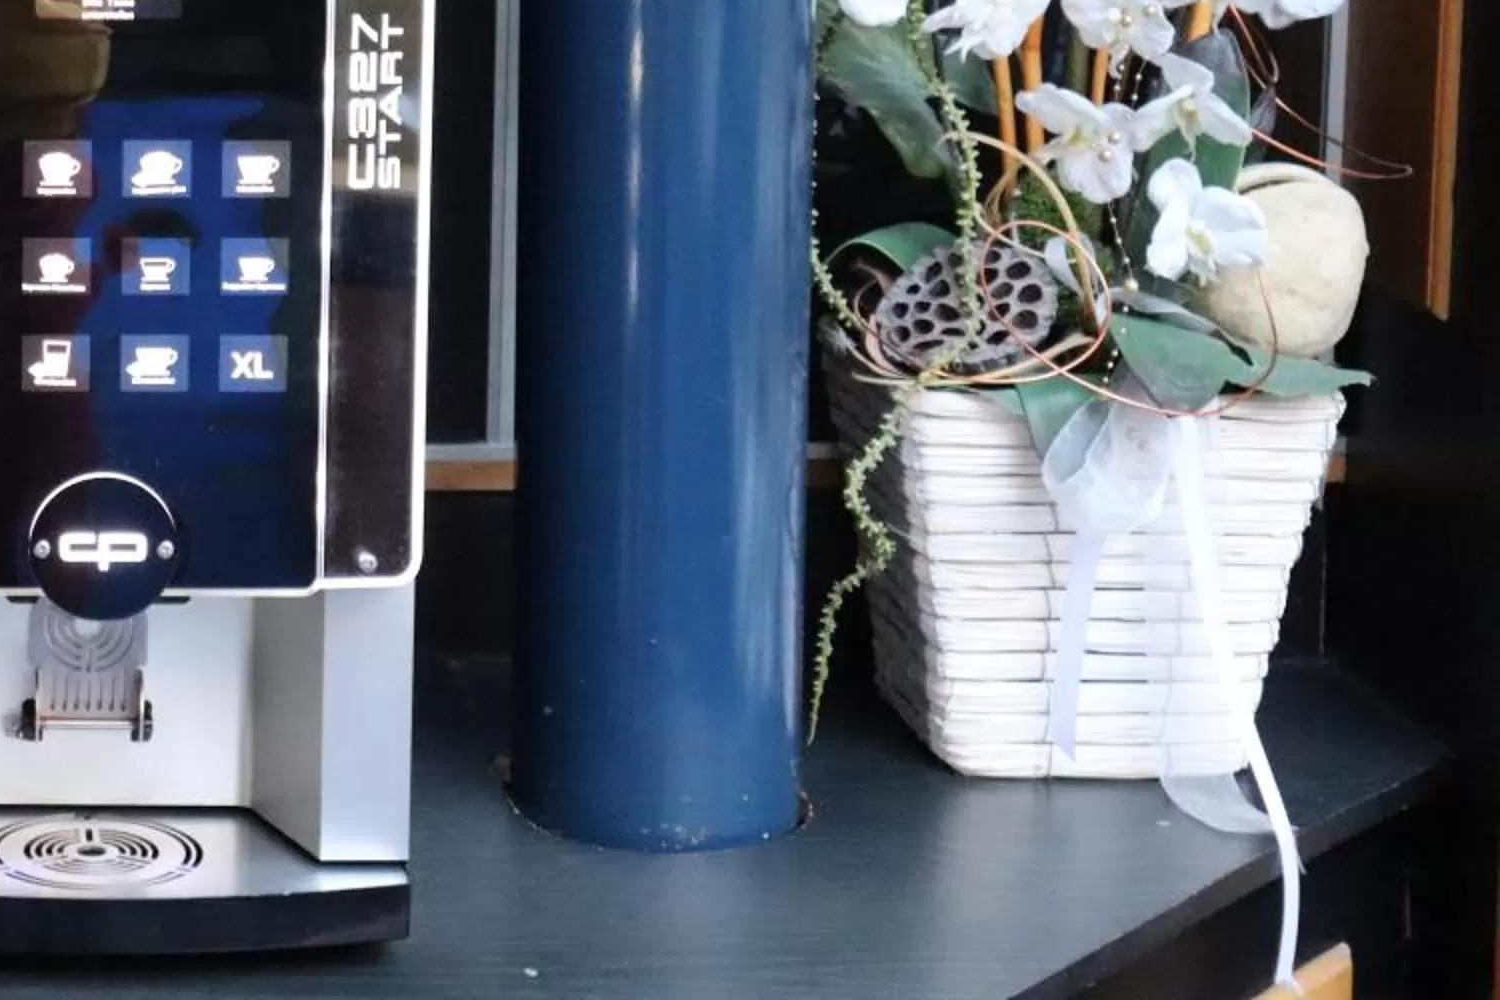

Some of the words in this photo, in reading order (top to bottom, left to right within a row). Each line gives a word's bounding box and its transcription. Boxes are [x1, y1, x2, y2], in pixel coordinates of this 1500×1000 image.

[347, 12, 379, 190] C327
[377, 12, 405, 190] START
[230, 350, 275, 380] XL
